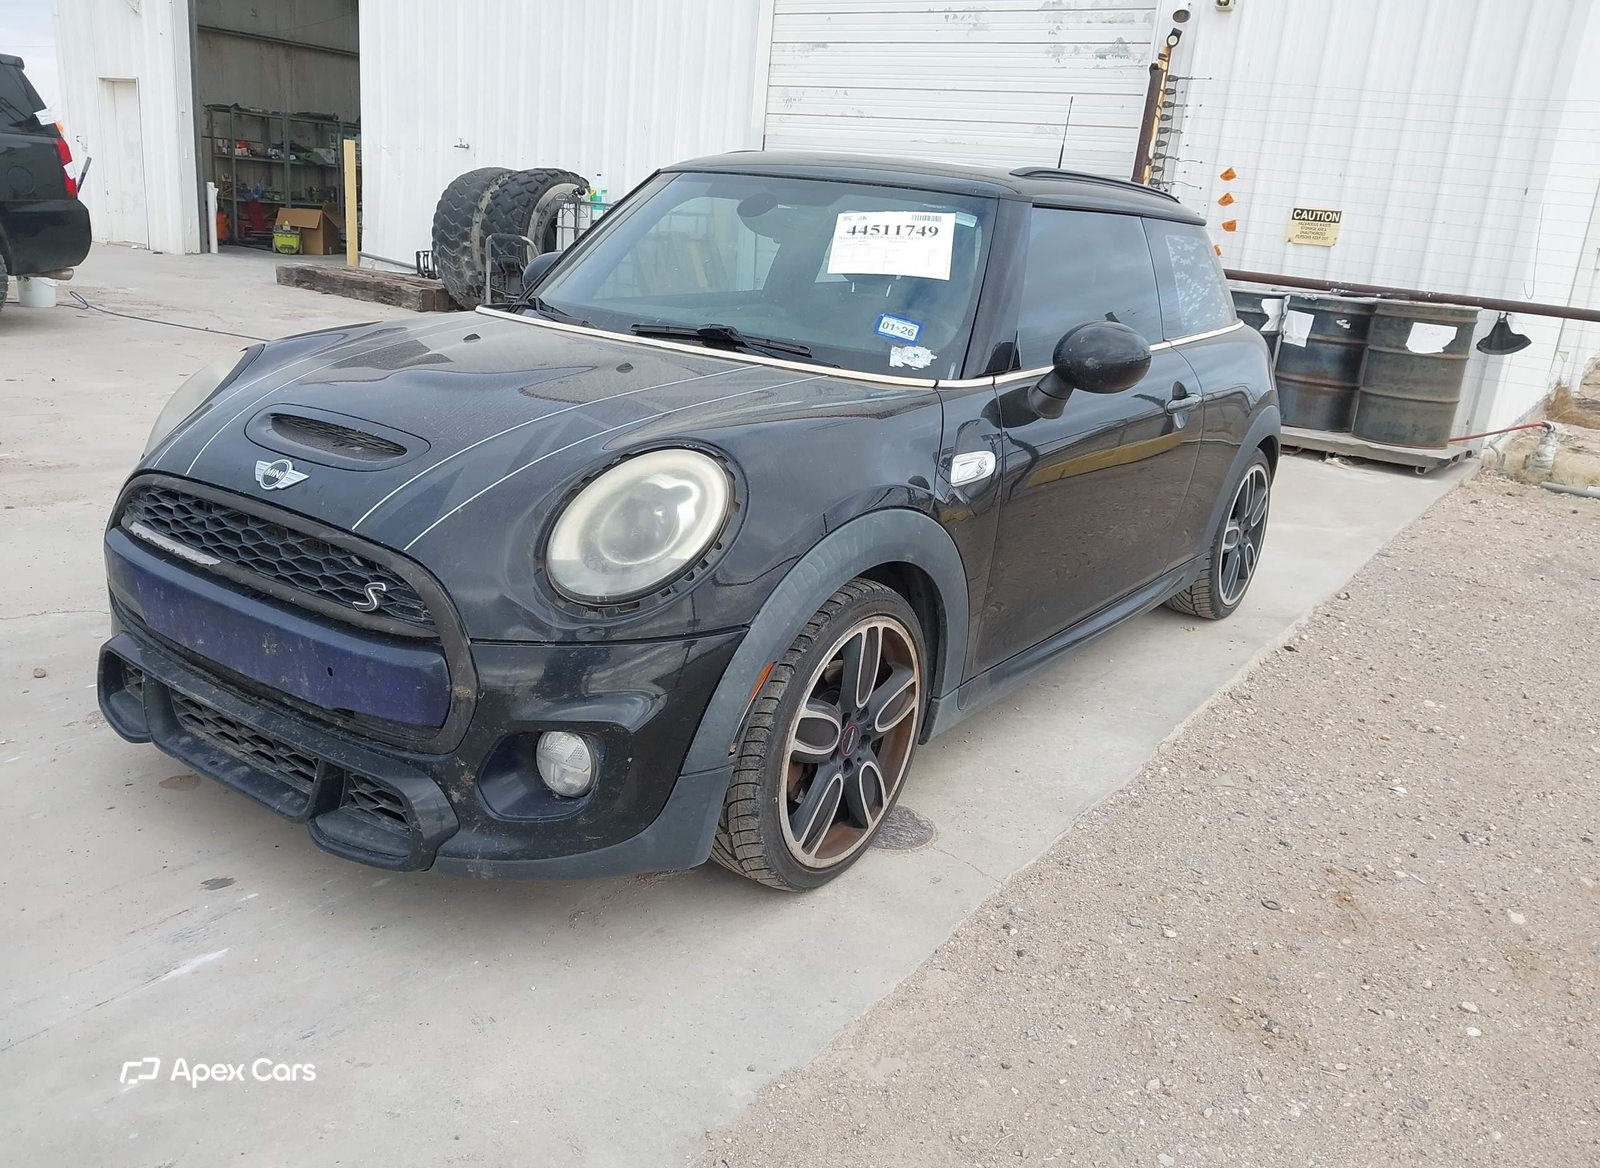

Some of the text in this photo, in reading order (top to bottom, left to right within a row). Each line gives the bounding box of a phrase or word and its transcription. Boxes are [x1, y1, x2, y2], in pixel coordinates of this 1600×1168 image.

[1294, 210, 1340, 222] CAUTION
[846, 224, 939, 238] 44511749
[264, 467, 285, 479] MINI
[352, 582, 387, 612] S
